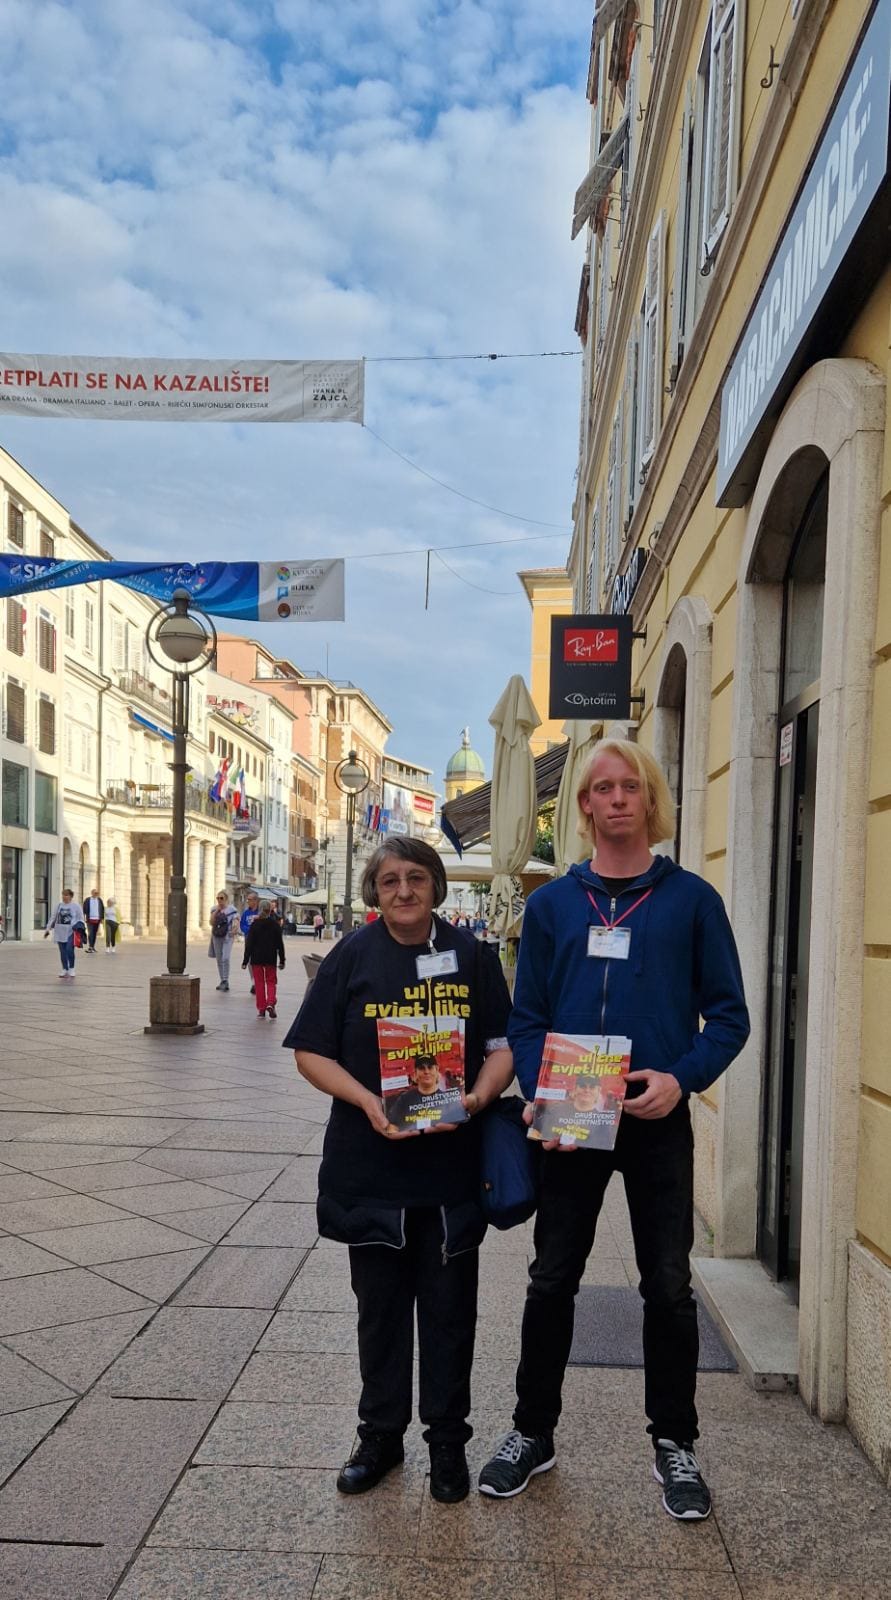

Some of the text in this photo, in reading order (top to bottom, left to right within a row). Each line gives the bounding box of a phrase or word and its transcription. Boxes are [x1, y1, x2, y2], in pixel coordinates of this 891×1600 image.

[0, 370, 269, 393] ETPLATI SE NA KAZALIŠTE!
